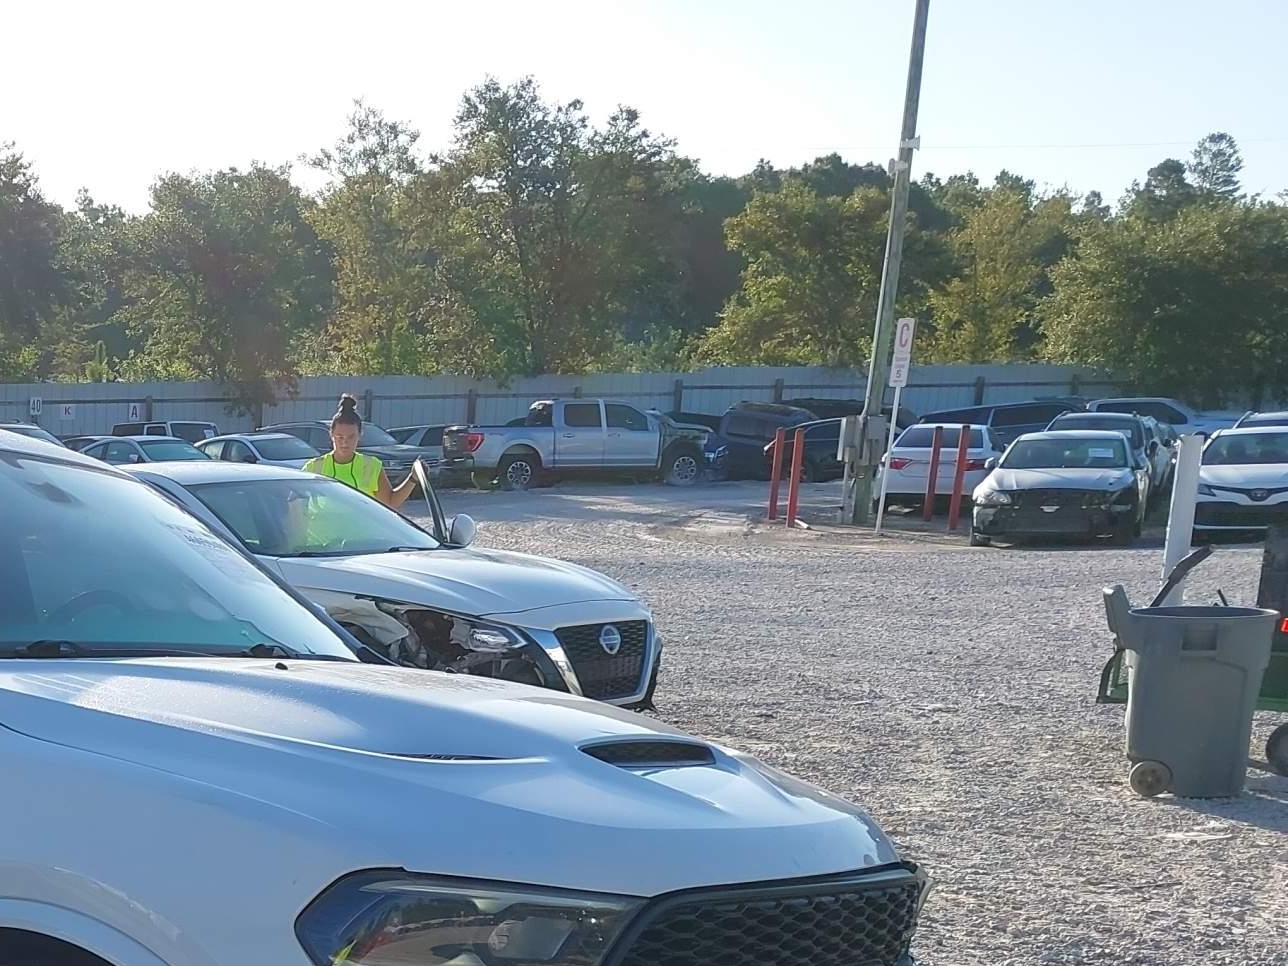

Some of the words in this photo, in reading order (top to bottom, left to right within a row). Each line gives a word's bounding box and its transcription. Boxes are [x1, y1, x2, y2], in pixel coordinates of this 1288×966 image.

[899, 322, 910, 348] C
[31, 399, 41, 413] 40
[64, 406, 72, 416] K
[130, 405, 139, 418] A
